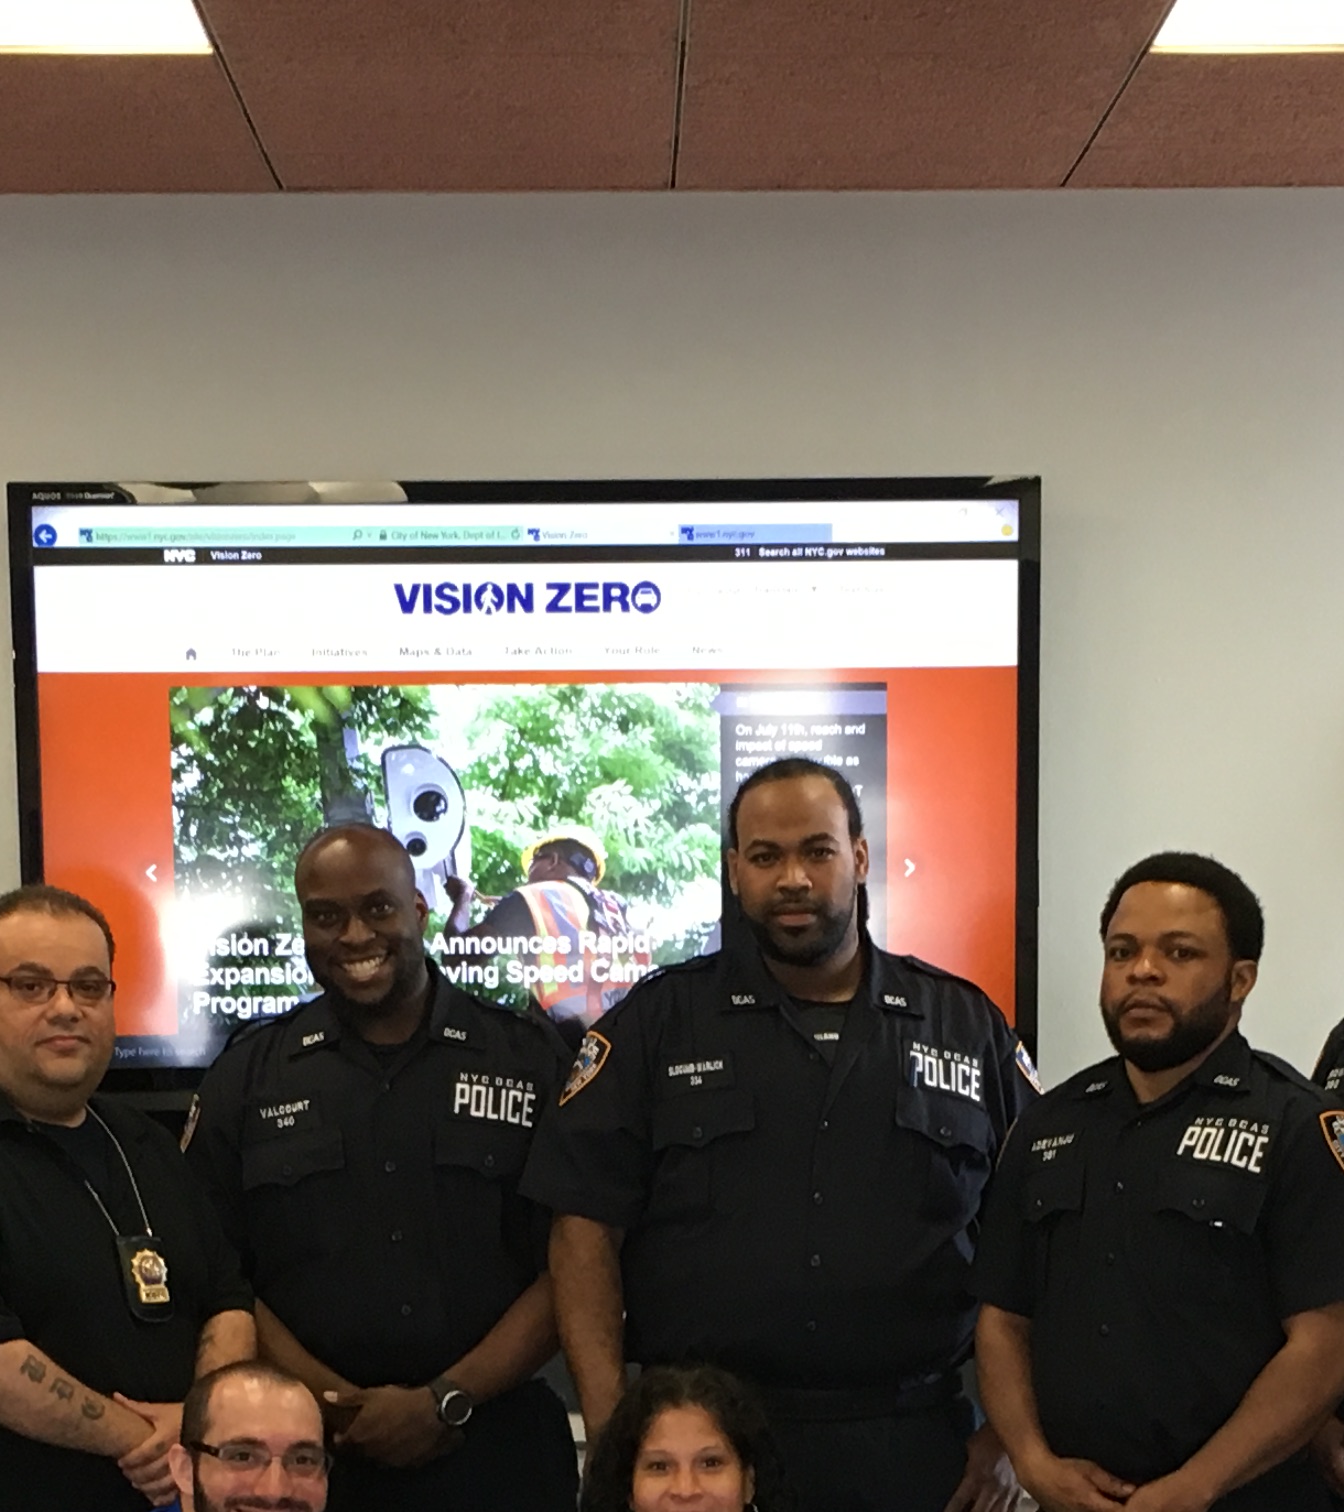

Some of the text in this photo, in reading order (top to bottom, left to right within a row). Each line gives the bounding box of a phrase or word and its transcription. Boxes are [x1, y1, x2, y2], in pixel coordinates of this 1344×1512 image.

[163, 549, 263, 562] NYC Vision Zero
[735, 547, 751, 557] 311
[759, 546, 790, 557] Search
[805, 546, 844, 560] NYC.gov
[846, 546, 885, 557] websites
[394, 580, 661, 615] VISION ZERO
[399, 647, 430, 658] Maps
[446, 647, 473, 657] Data
[735, 723, 752, 736] On
[755, 723, 778, 738] July
[844, 723, 866, 735] and
[735, 738, 823, 753] impact of speed
[274, 932, 306, 957] Ze
[430, 931, 571, 955] Announces
[578, 930, 652, 957] Rapid
[439, 960, 500, 989] ving
[506, 960, 584, 989] Speed
[192, 990, 300, 1020] Program
[912, 1041, 979, 1067] NYC DCAS
[459, 1072, 534, 1091] NYC DCAS
[909, 1050, 981, 1102] POLICE
[259, 1099, 311, 1120] VALCOURT
[454, 1082, 537, 1128] POLICE
[1194, 1116, 1270, 1134] NYC DCAS
[1176, 1126, 1269, 1174] POLICE
